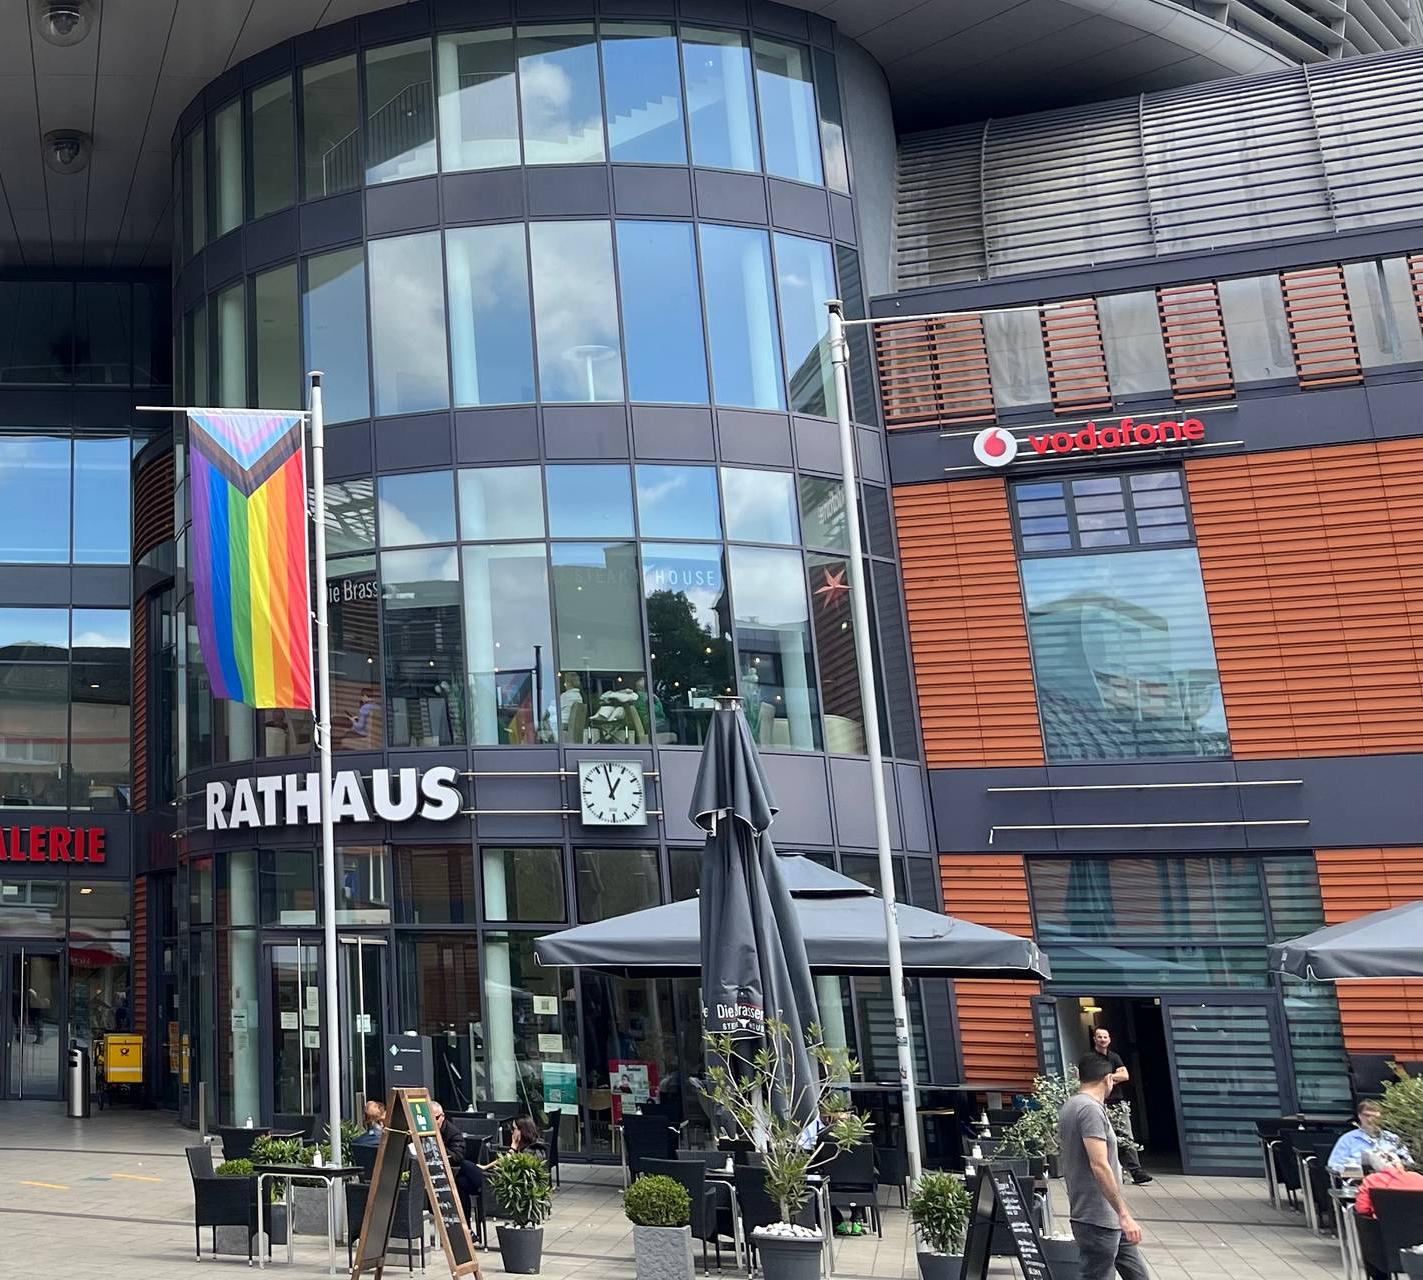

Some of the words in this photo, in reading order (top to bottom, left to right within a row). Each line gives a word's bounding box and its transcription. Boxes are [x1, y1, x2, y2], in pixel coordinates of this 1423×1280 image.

[1028, 417, 1205, 455] vodafone
[343, 579, 378, 602] Brass
[655, 569, 716, 587] HOUSE
[206, 766, 463, 831] RATHAUS
